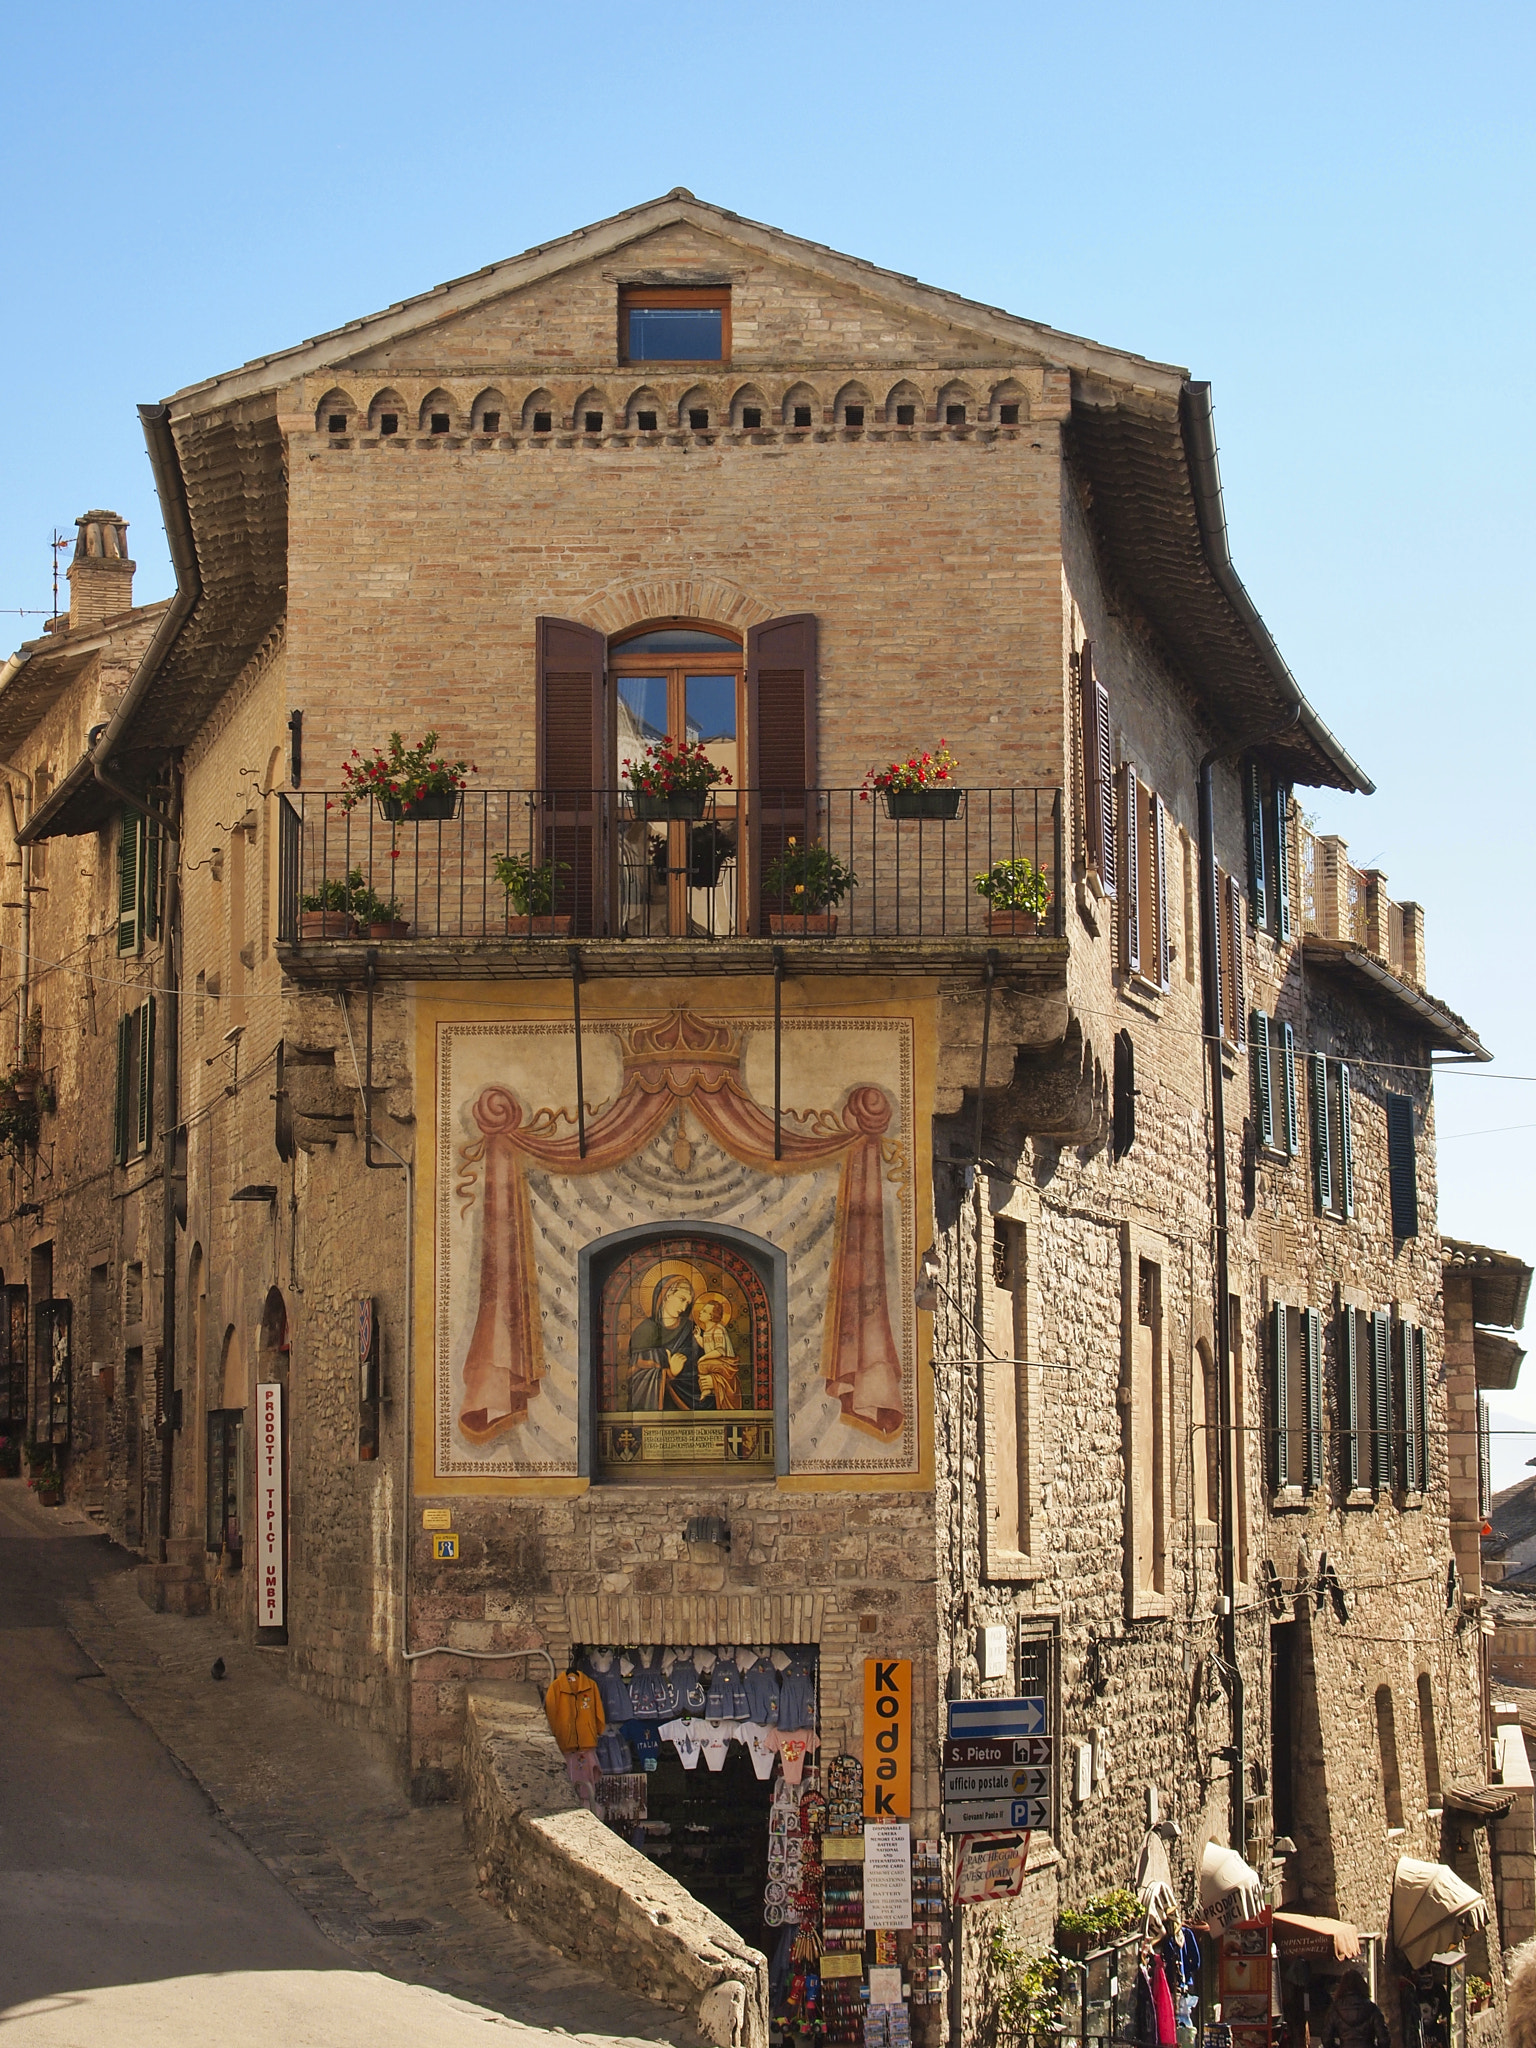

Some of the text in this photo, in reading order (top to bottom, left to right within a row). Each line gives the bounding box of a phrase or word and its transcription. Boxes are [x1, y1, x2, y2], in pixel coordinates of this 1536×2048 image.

[265, 1390, 276, 1620] PRODOTTI TIPICI UMBRI
[637, 1741, 659, 1750] ITALIA
[874, 1662, 900, 1815] Kodak
[952, 1746, 1002, 1761] S. Pietro
[949, 1774, 1009, 1792] ufficio postale
[1014, 1804, 1026, 1823] P
[967, 1849, 1019, 1865] PARCHEGGIO
[966, 1868, 1015, 1881] VESCOVADO
